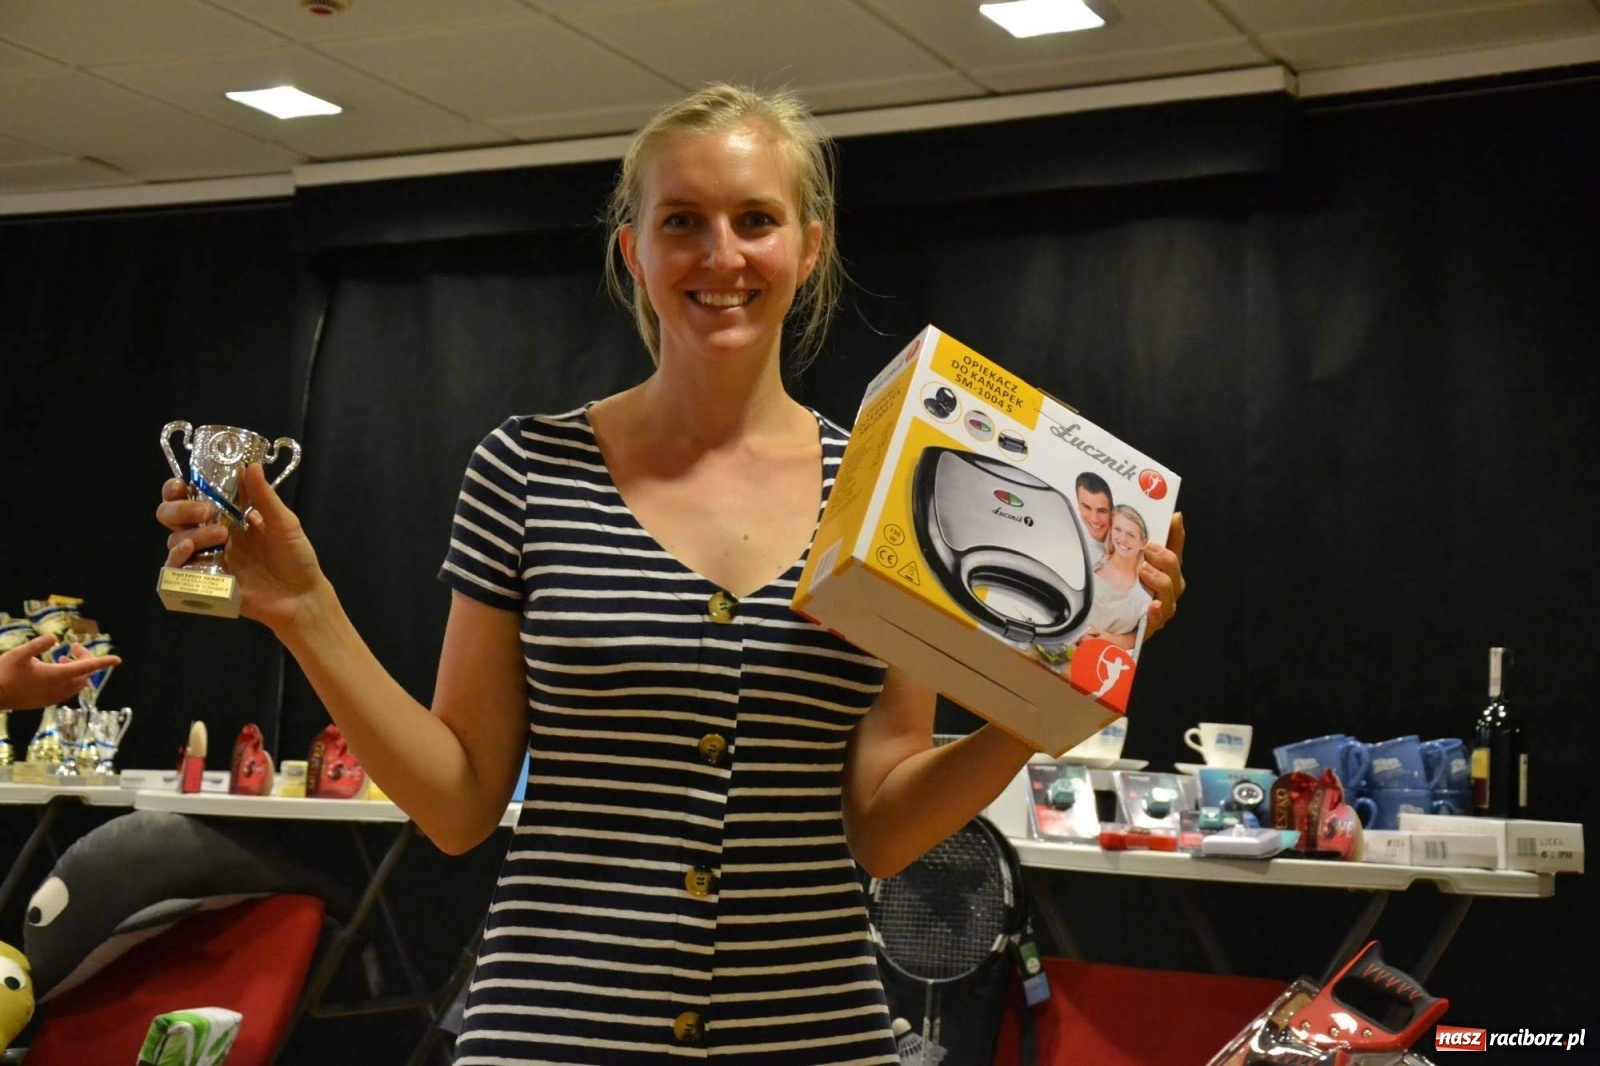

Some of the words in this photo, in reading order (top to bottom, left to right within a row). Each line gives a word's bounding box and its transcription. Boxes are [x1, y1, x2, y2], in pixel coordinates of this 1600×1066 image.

[951, 359, 968, 374] DO
[970, 372, 1023, 408] KANAPEK
[955, 374, 1004, 408] SM-1004
[1006, 404, 1013, 413] S
[963, 356, 1018, 393] OPIEKACZ
